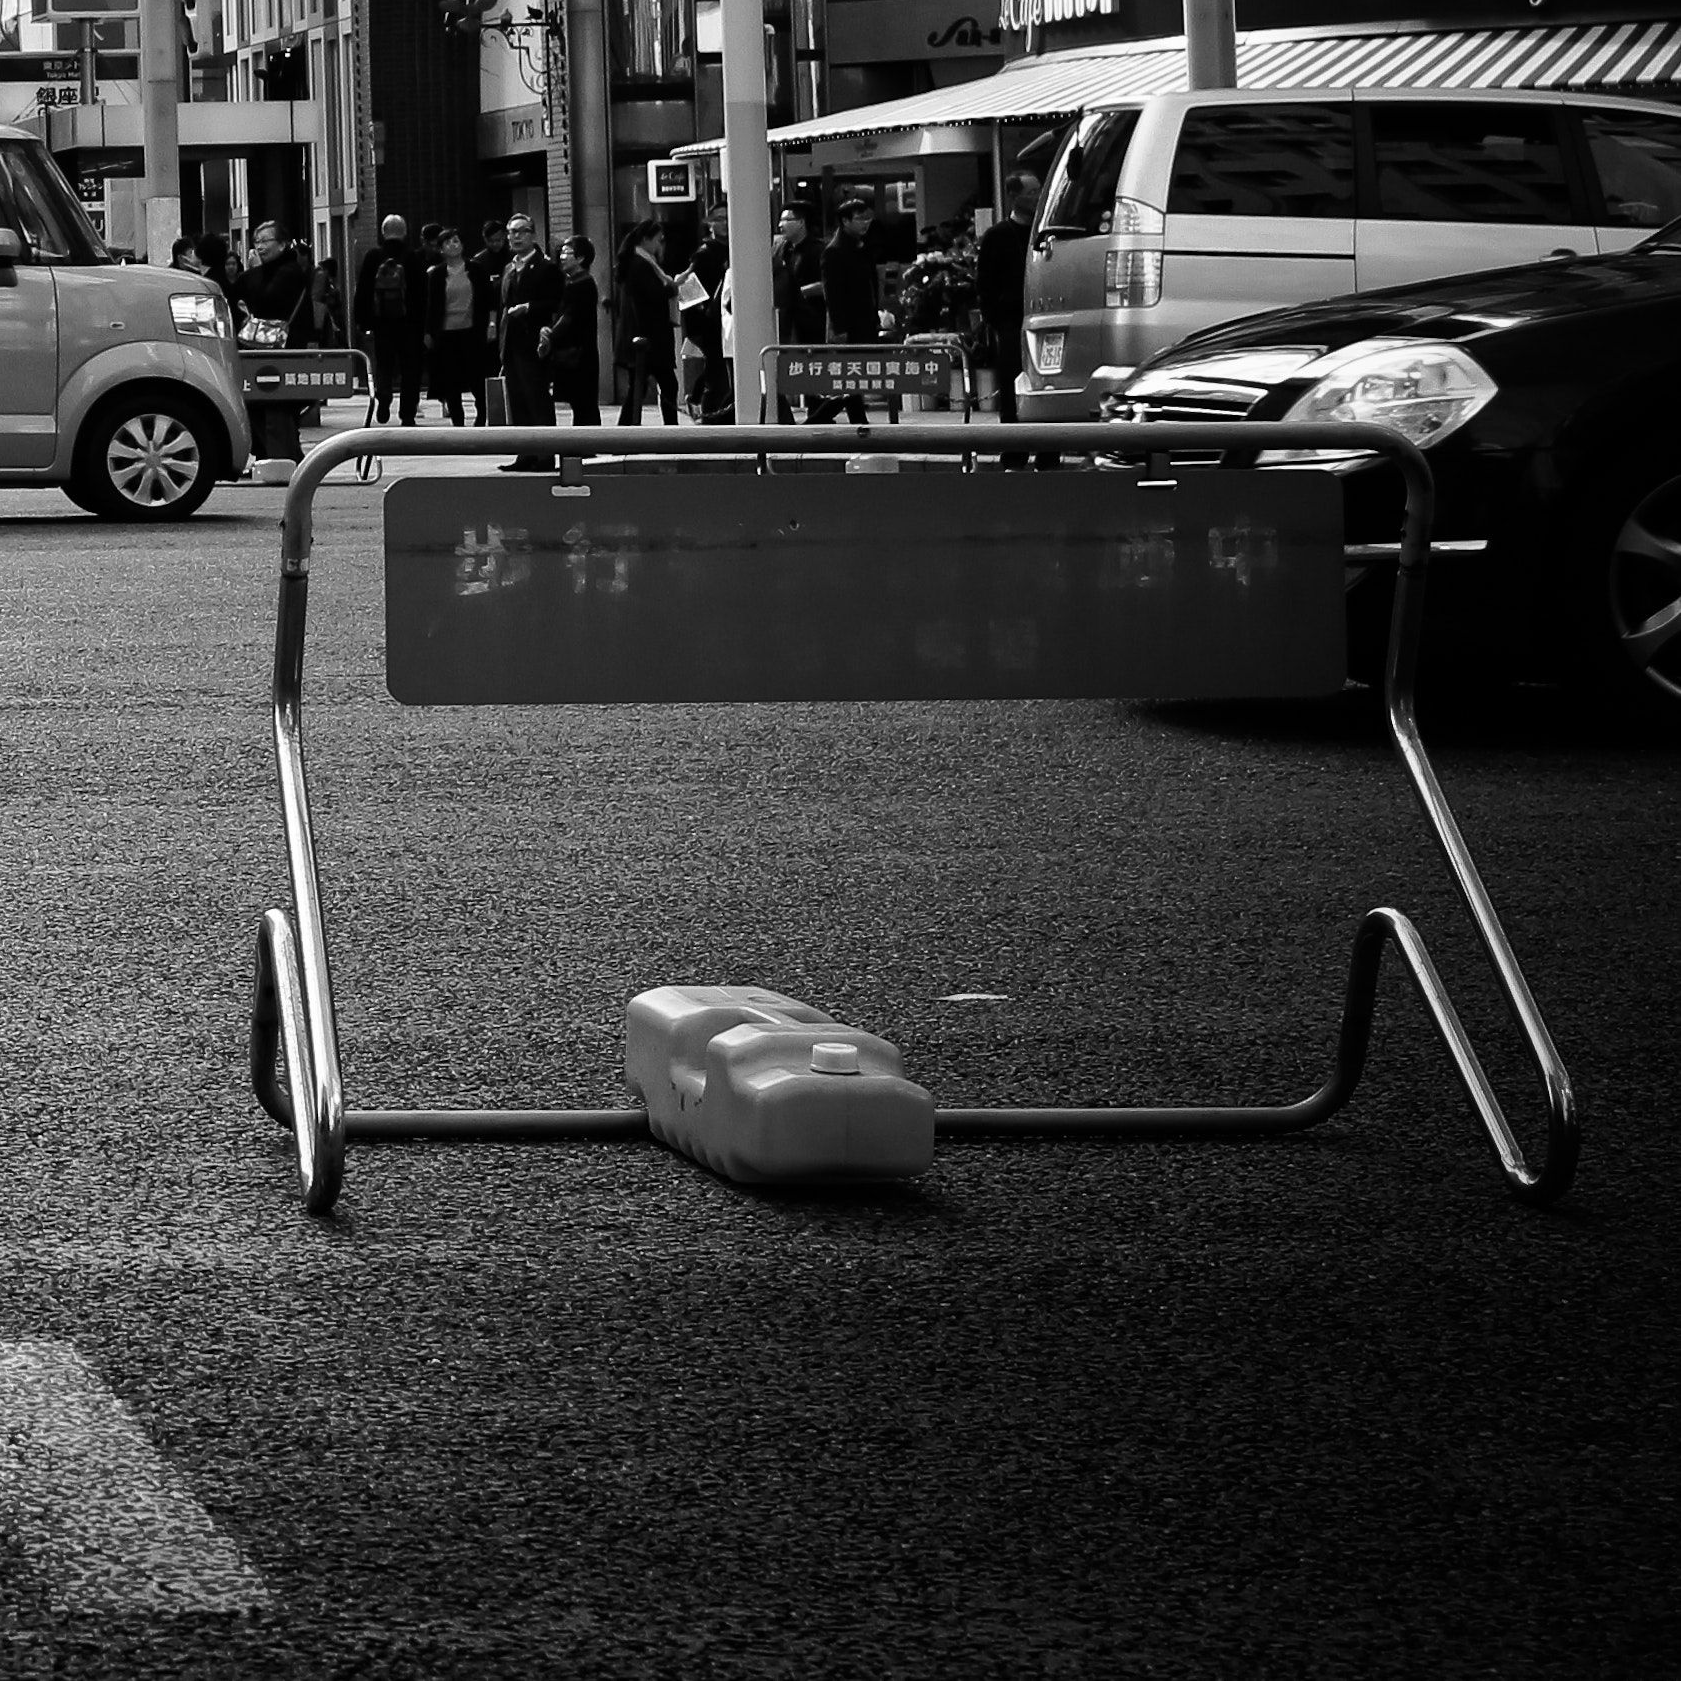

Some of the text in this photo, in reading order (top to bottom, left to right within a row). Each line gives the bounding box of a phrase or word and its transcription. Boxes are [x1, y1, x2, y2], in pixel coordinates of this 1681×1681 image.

[927, 16, 1001, 49] San-a
[42, 60, 80, 71] 東京メト
[788, 360, 939, 377] 歩行者天国実施中
